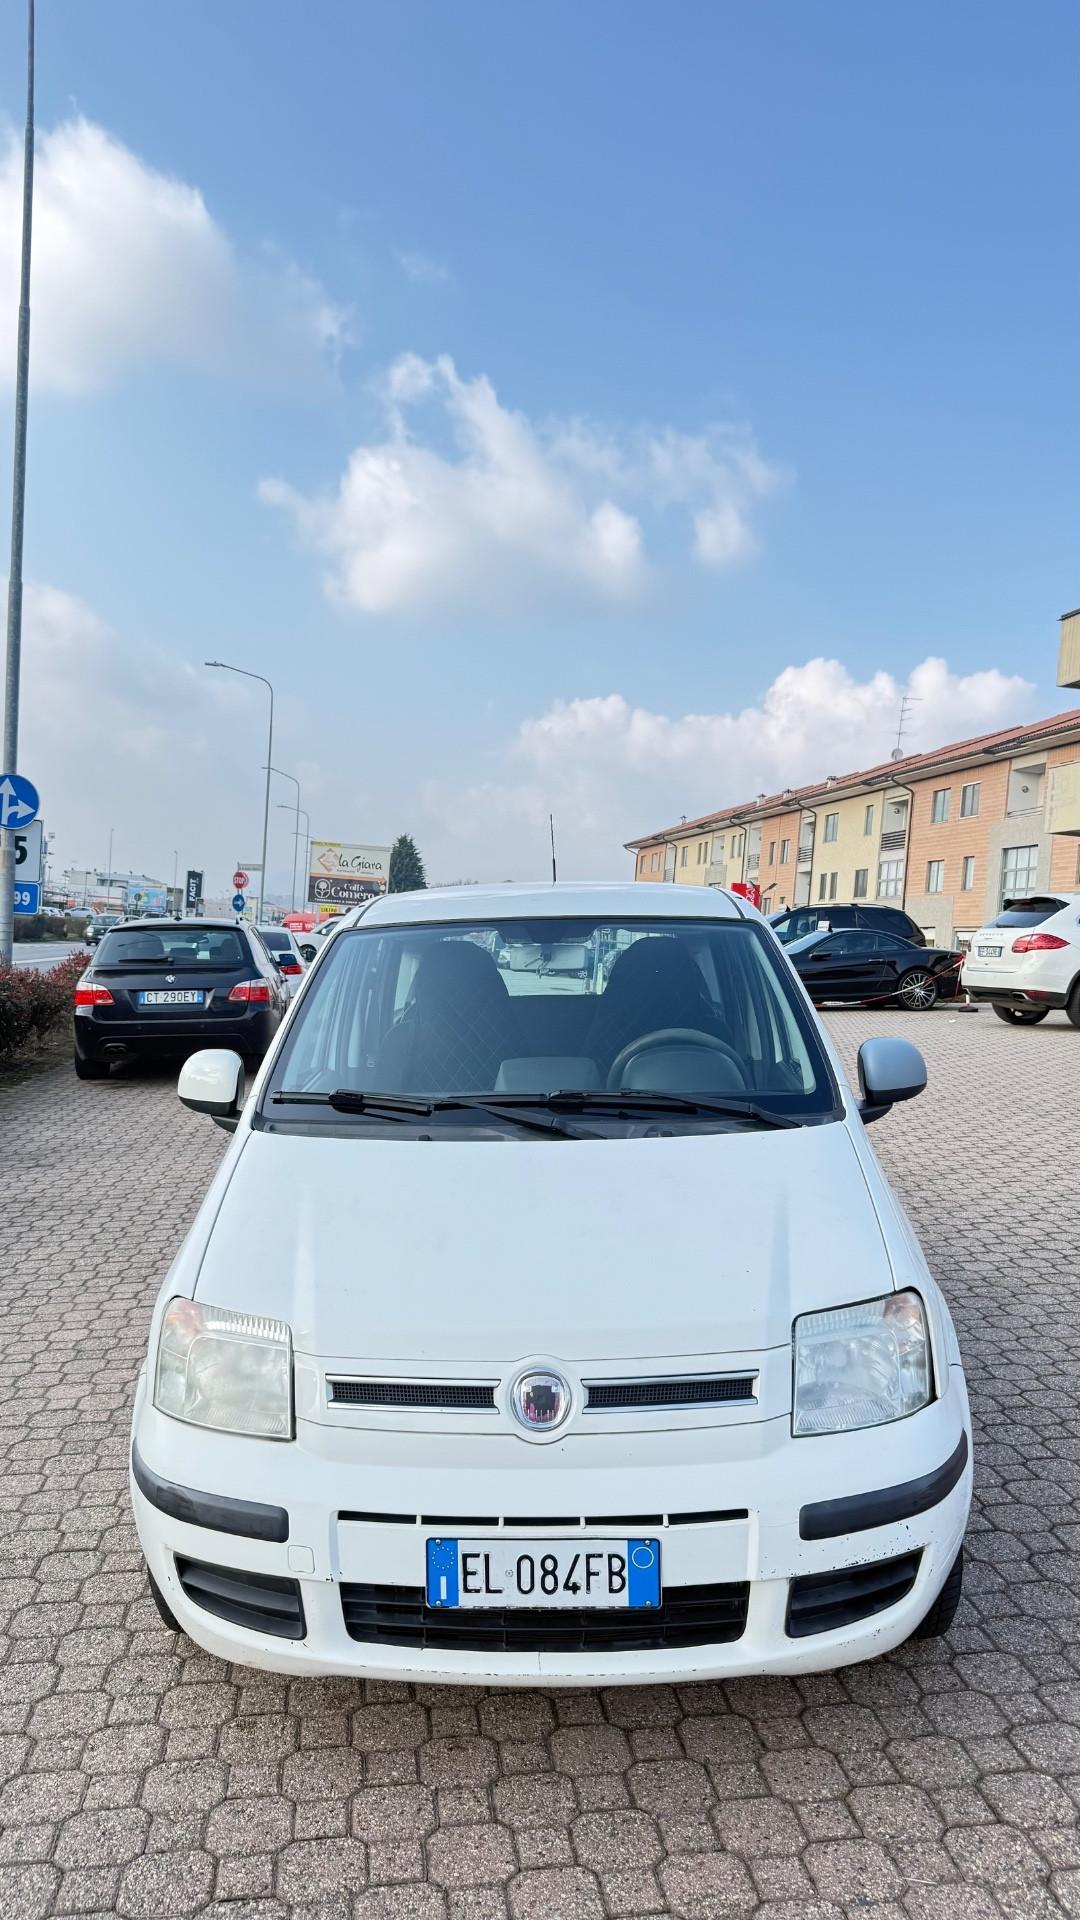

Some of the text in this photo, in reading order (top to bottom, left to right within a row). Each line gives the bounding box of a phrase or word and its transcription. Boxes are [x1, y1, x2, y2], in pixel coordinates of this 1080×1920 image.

[15, 836, 27, 865] 5
[350, 855, 382, 872] Giara
[233, 876, 245, 884] STOP
[146, 991, 196, 1003] CT 290EY
[461, 1552, 627, 1595] EL 084FB
